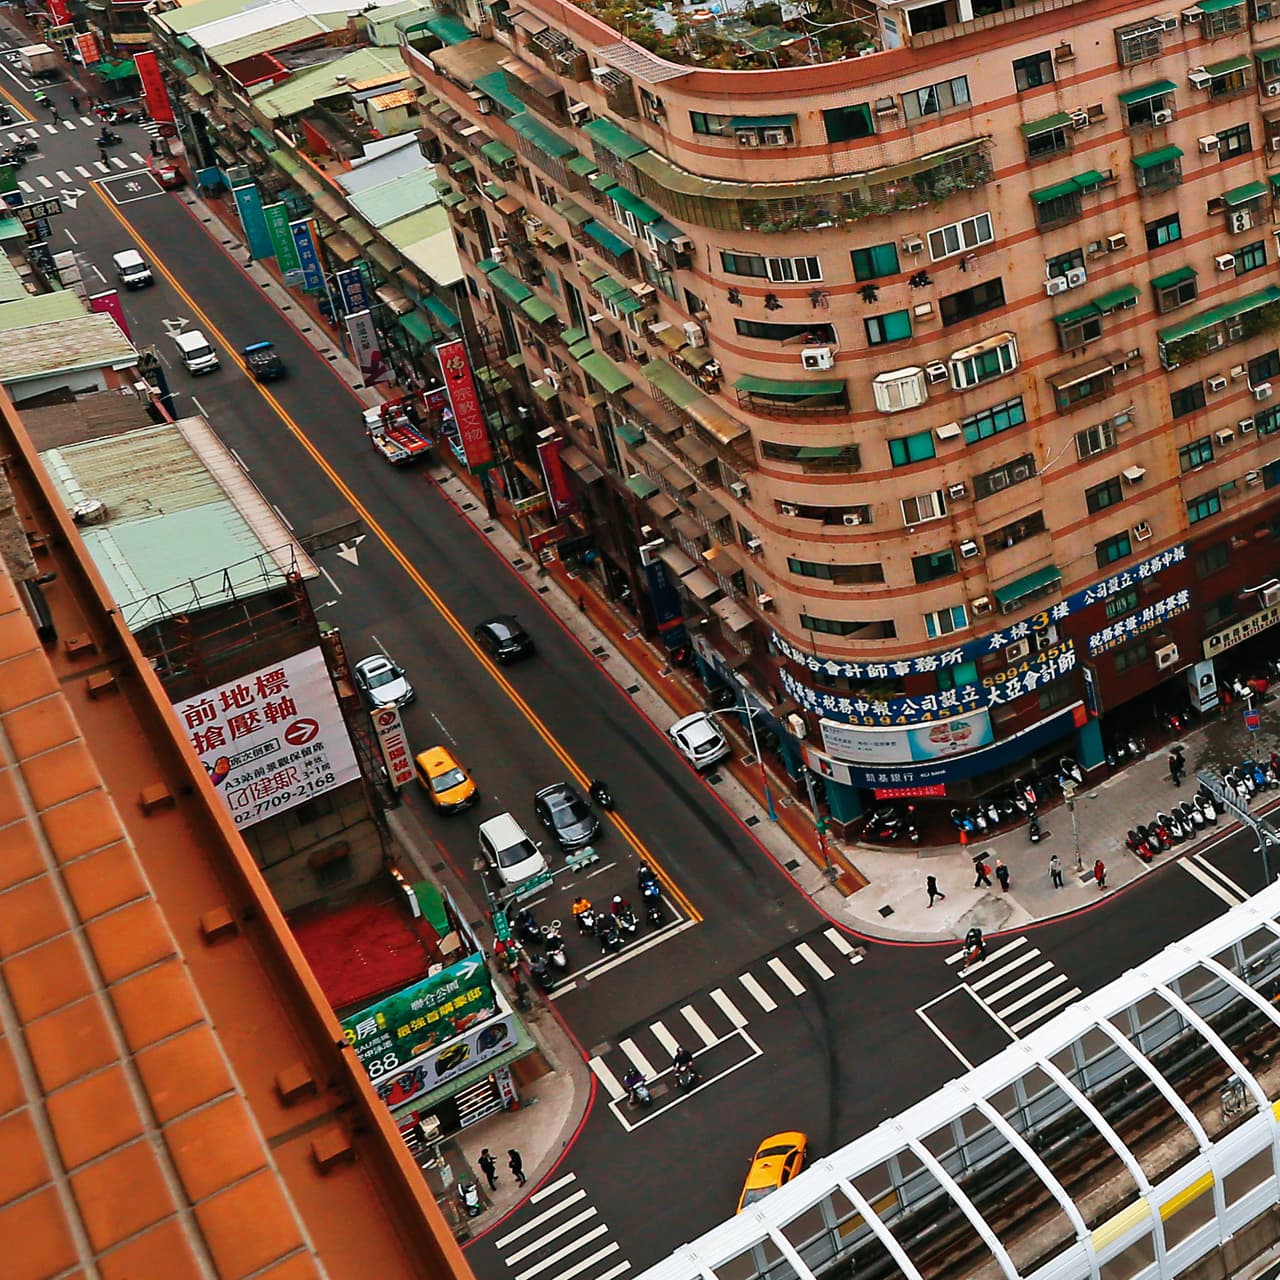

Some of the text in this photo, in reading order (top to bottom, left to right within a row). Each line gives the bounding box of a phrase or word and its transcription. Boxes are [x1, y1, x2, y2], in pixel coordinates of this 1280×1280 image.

[982, 638, 1074, 689] 8994-4511
[987, 649, 1077, 708] 大亞會計師
[181, 667, 290, 730] 前地標
[848, 701, 977, 725] 8994-4511
